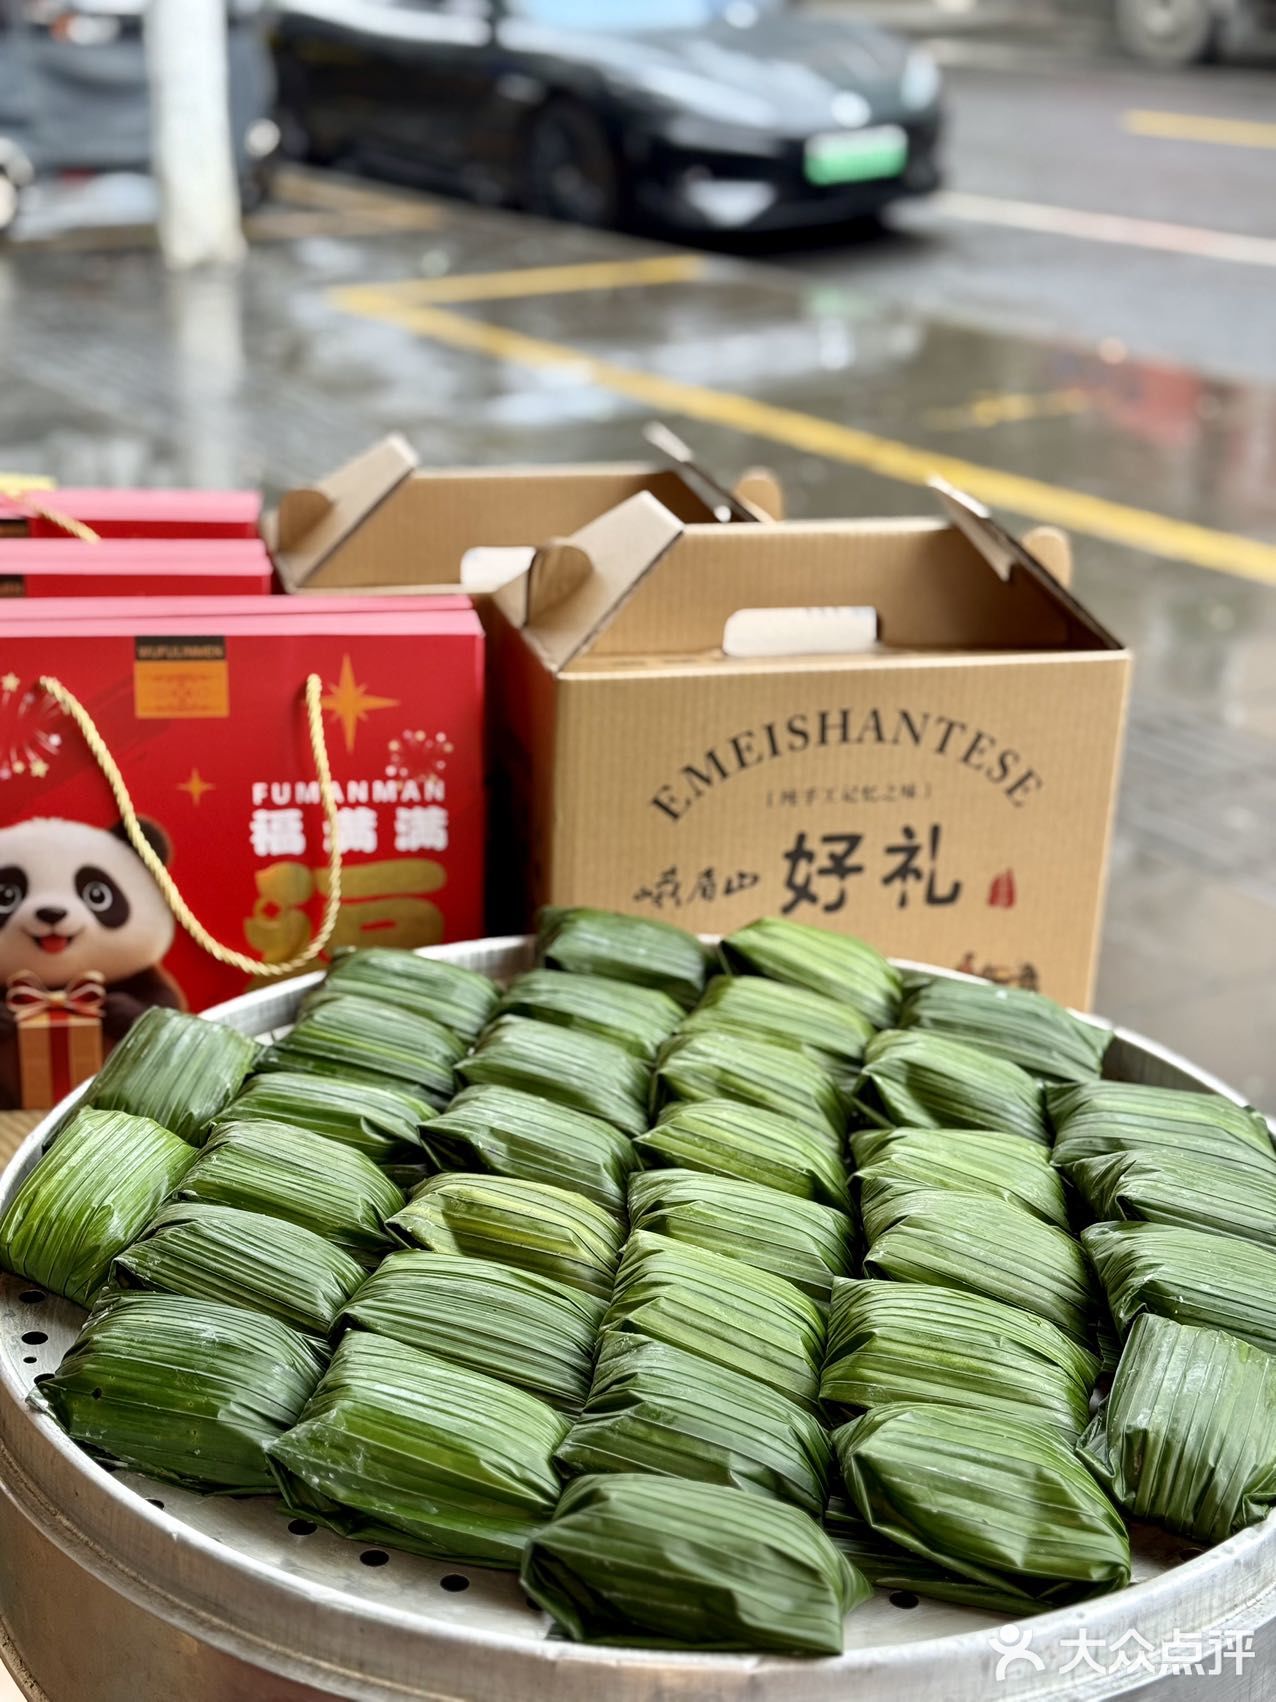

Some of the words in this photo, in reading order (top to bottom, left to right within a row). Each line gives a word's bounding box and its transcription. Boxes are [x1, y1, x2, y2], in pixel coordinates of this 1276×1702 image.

[251, 779, 446, 806] FUMANMAN
[648, 707, 1045, 823] EMEISHANTESE
[780, 824, 963, 914] 好礼
